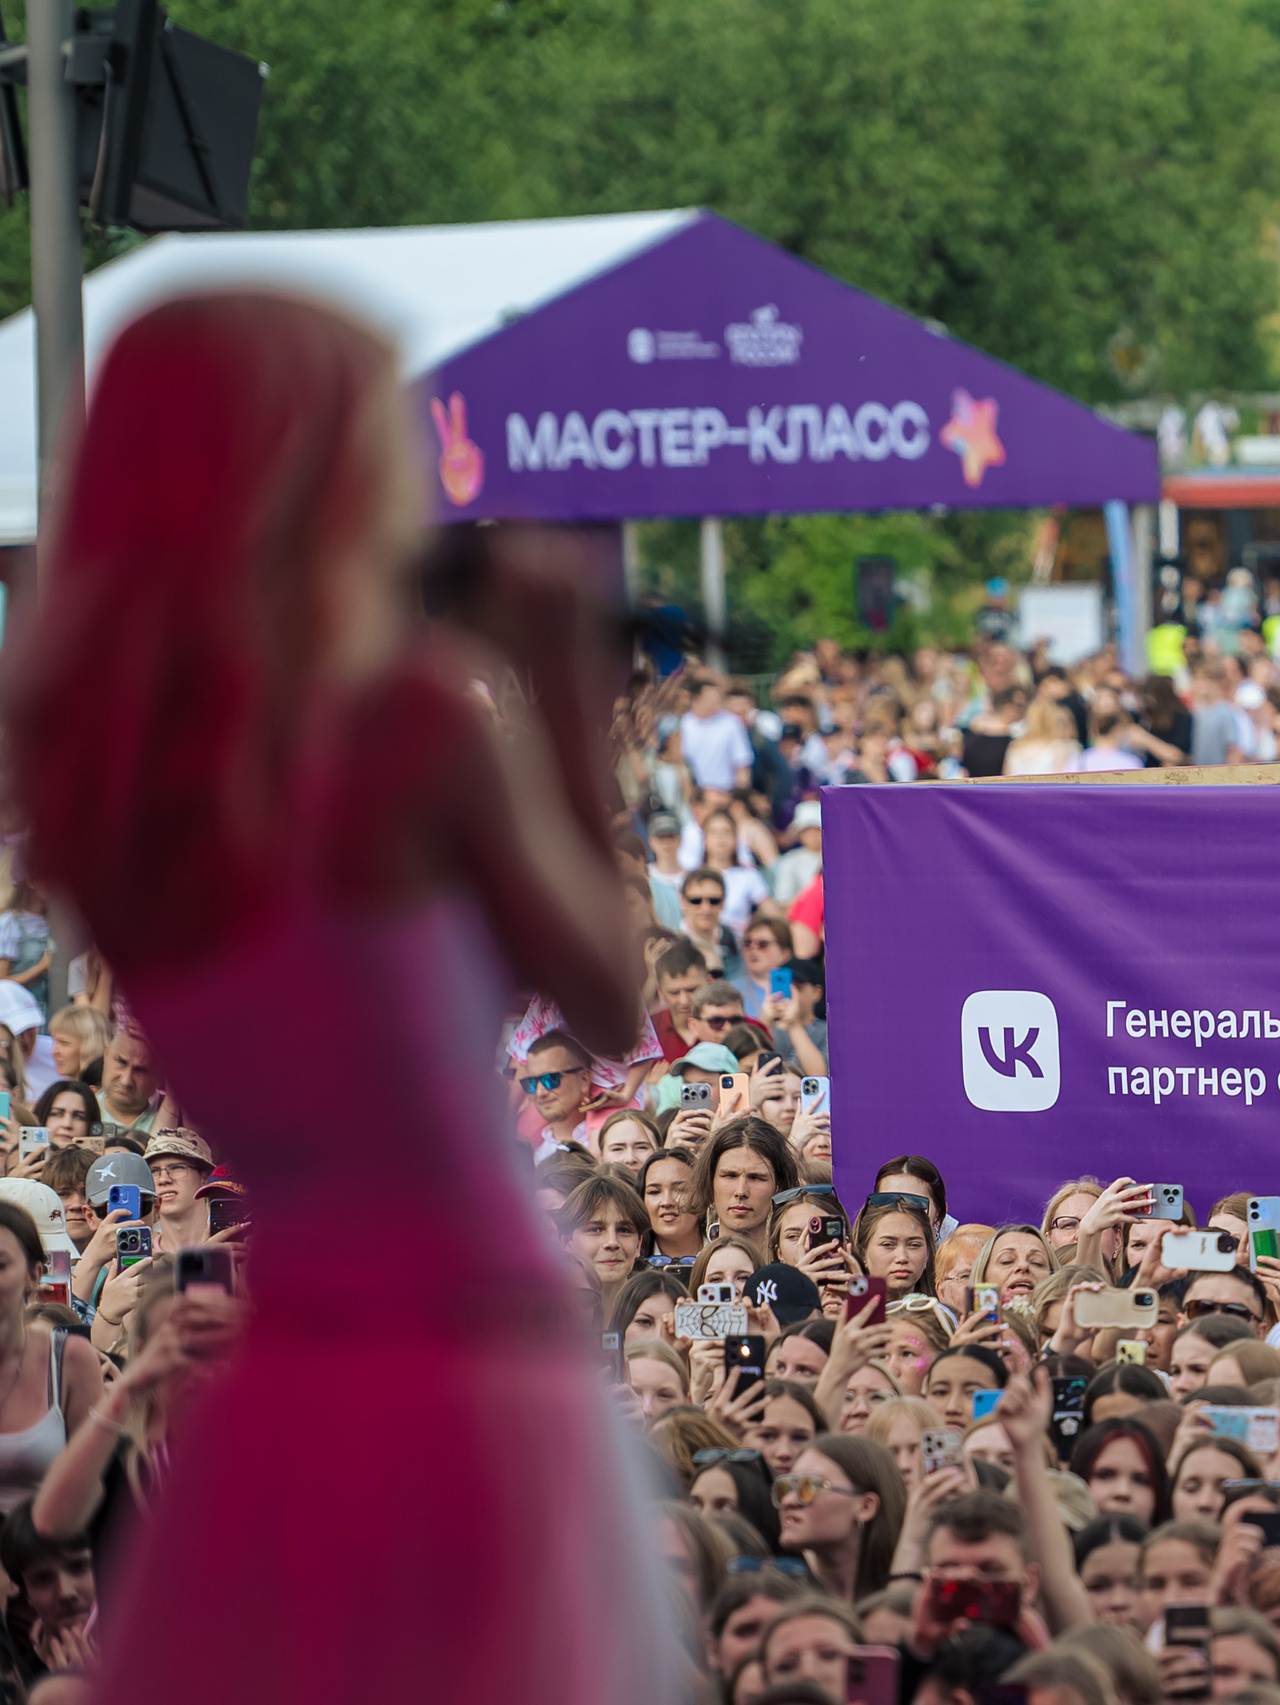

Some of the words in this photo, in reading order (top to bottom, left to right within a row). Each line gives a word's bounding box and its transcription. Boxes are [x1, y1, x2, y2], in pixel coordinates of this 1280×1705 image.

[505, 400, 931, 472] МАСТЕР-КЛАСС
[977, 1026, 1045, 1078] VK
[1107, 1065, 1267, 1106] партнер
[756, 1279, 778, 1305] NY
